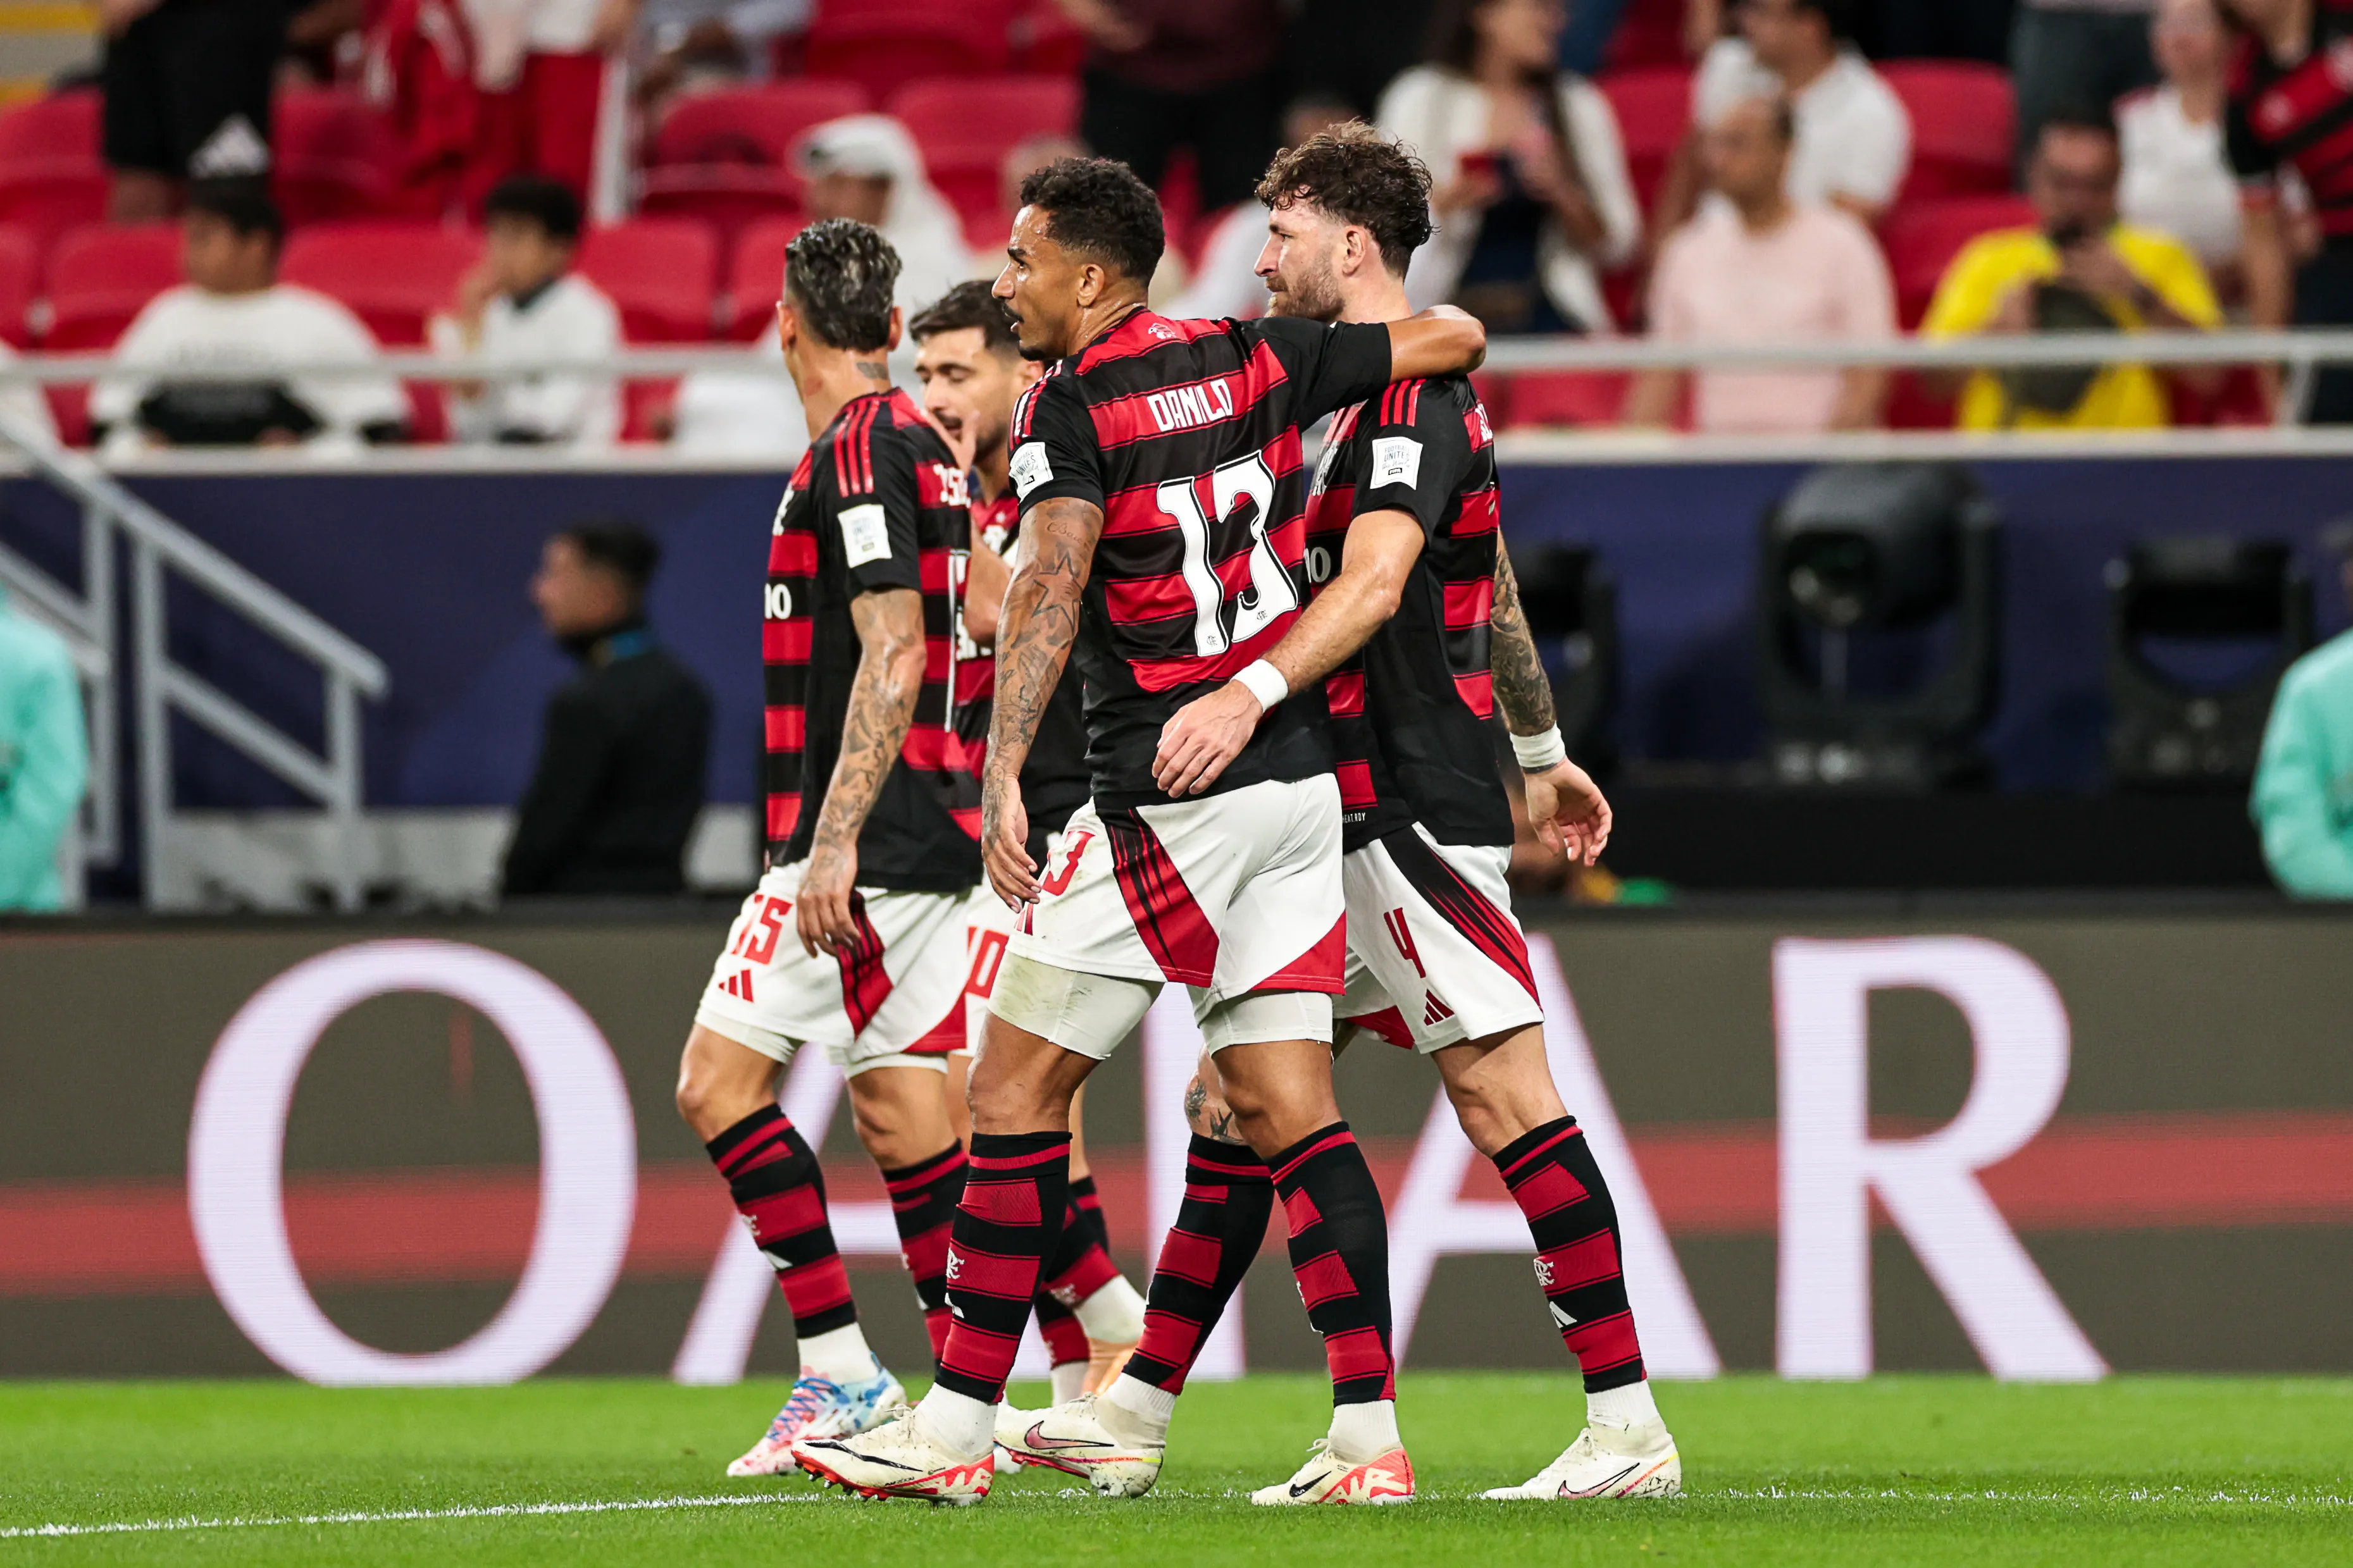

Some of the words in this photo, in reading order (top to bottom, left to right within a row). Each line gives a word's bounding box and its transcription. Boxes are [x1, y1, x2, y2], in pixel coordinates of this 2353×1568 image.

[1146, 378, 1233, 432] DANILO
[1384, 451, 1410, 462] UNITES
[1157, 450, 1299, 657] 13
[1041, 830, 1096, 896] 3
[1384, 907, 1425, 978] 4
